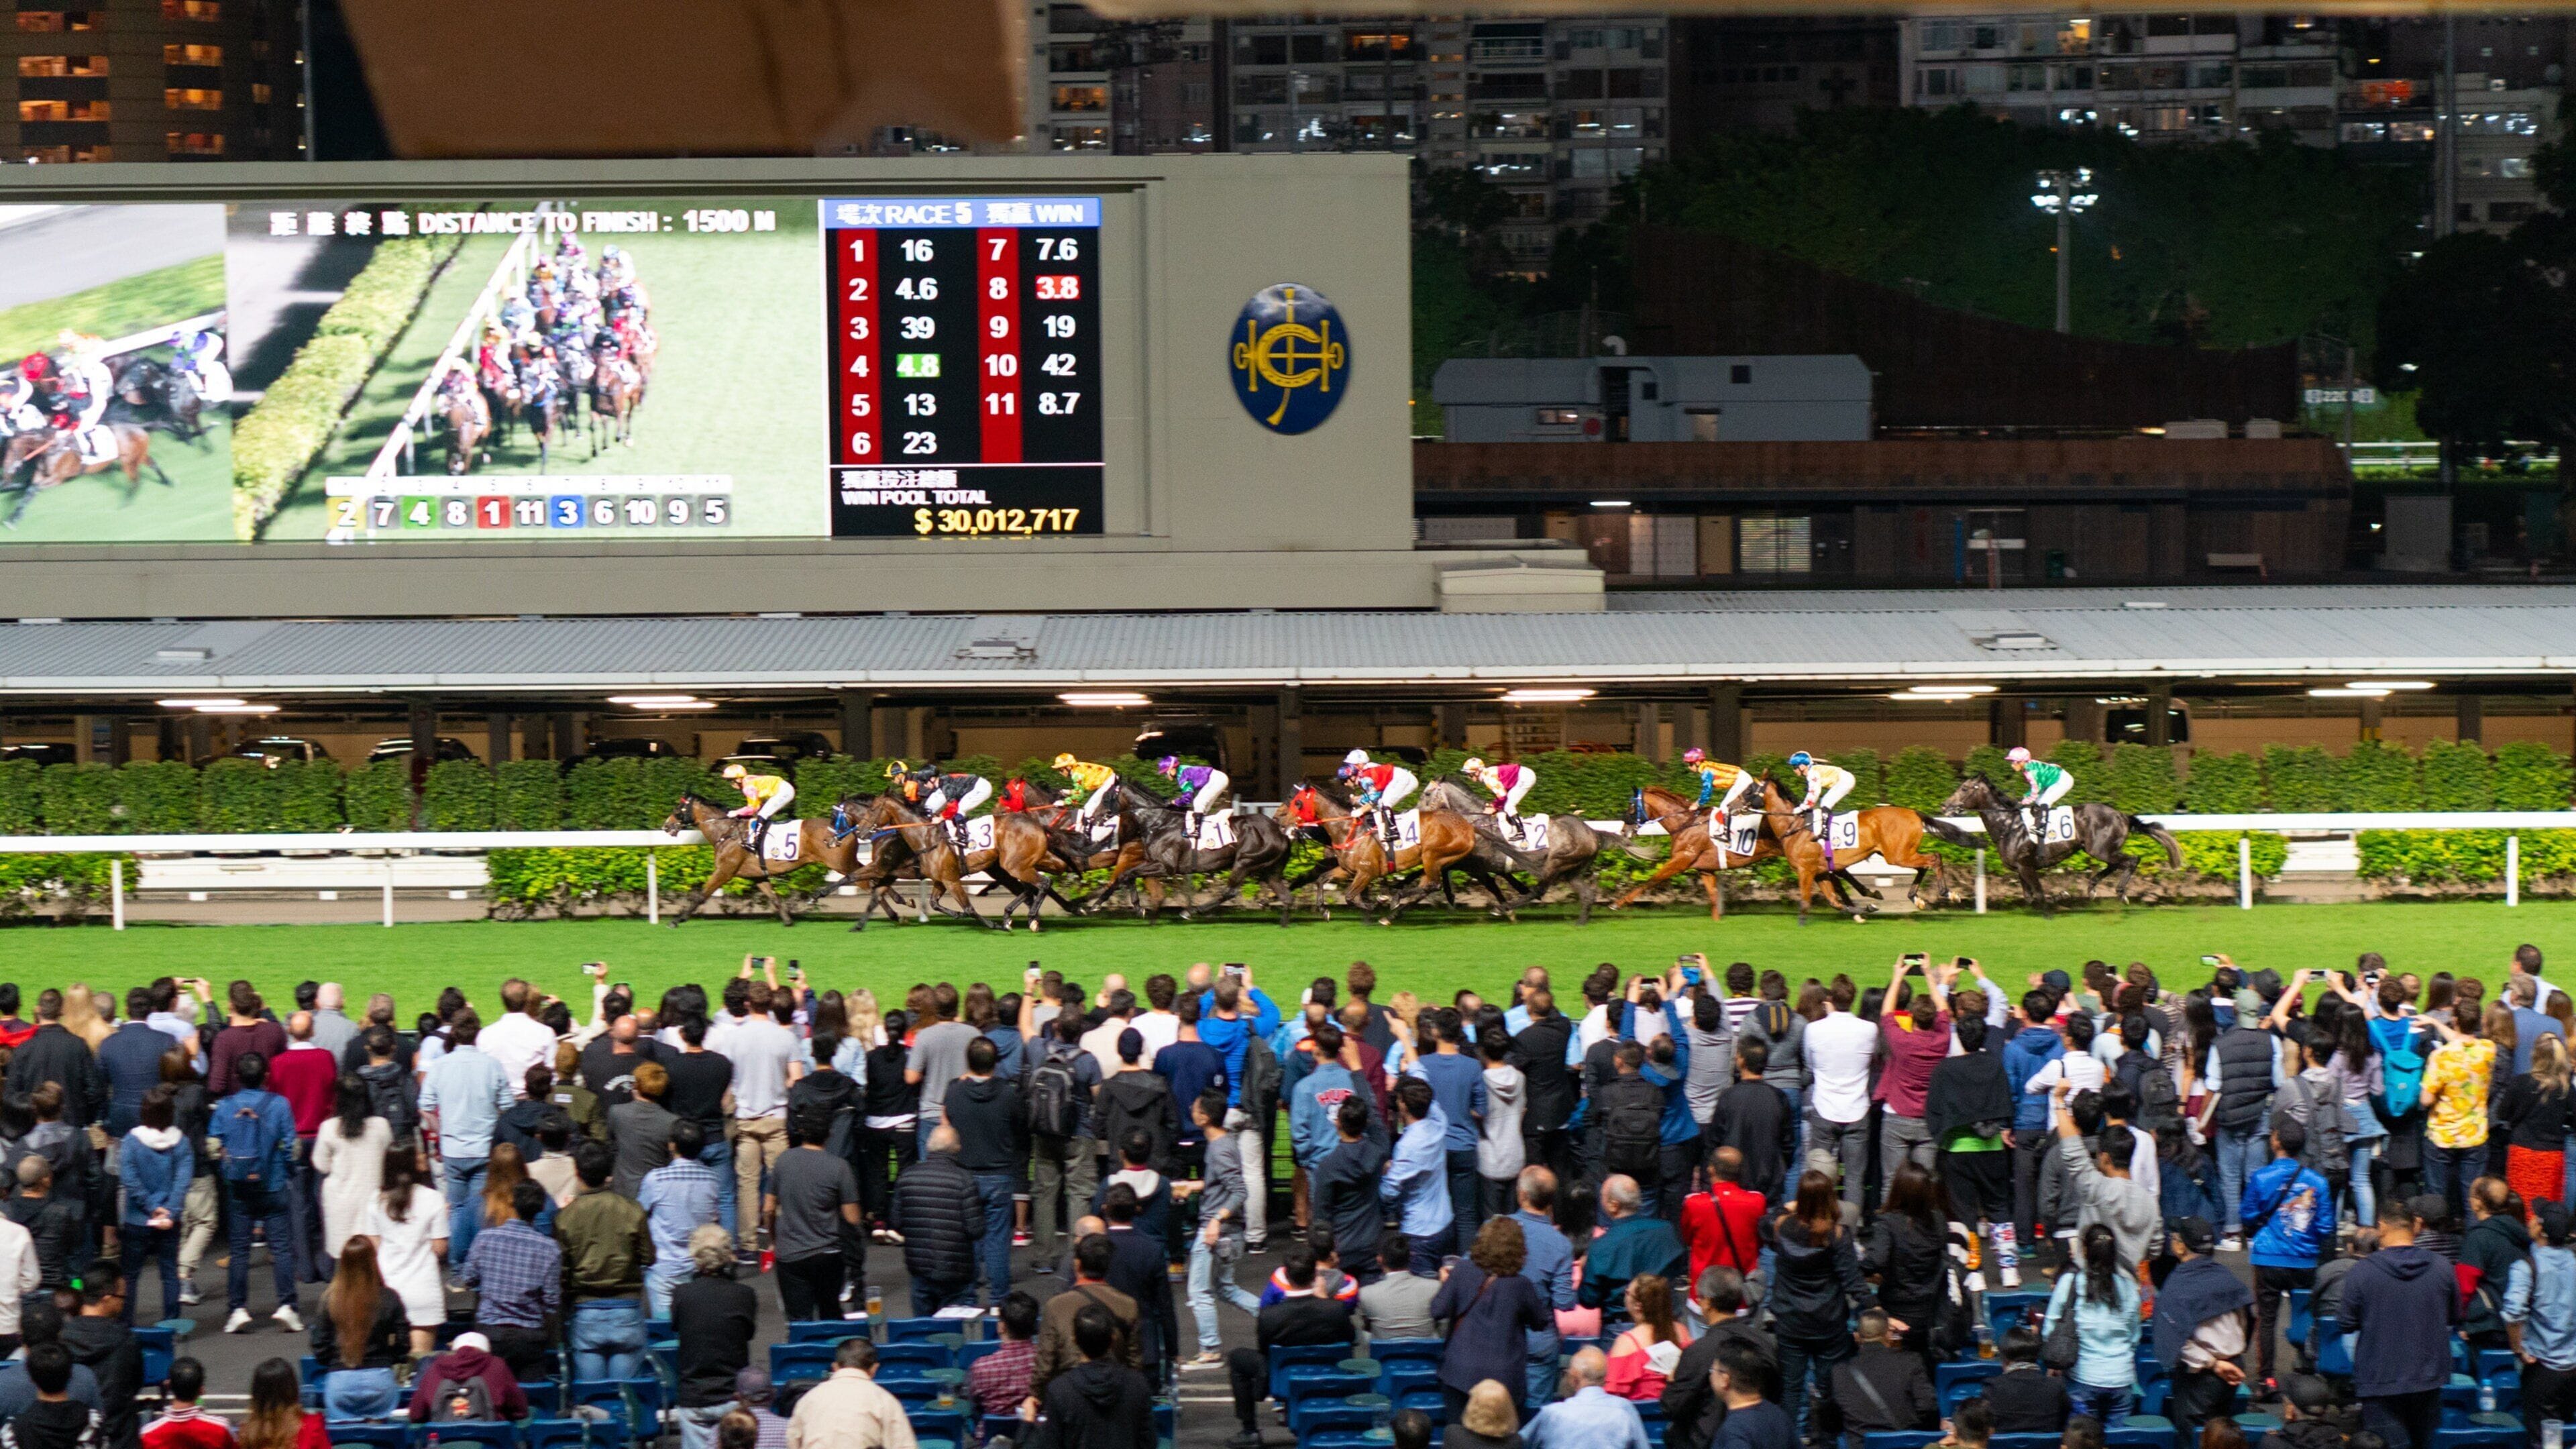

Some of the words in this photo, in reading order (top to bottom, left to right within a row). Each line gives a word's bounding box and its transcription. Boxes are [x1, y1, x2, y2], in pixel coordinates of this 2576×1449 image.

[419, 213, 536, 233] DISTANCE
[541, 212, 577, 233] TO
[583, 212, 657, 231] FINISH
[683, 210, 749, 232] 1500
[885, 206, 951, 223] RACE
[956, 203, 972, 223] 5
[1036, 205, 1083, 222] WIN
[851, 240, 863, 262] 1
[901, 239, 933, 262] 16
[989, 239, 1006, 260] 7
[1036, 238, 1078, 260] 7.6
[849, 278, 867, 301] 2
[896, 278, 938, 300] 4.6
[989, 277, 1008, 299] 8
[1037, 276, 1078, 299] 3.8
[851, 317, 869, 339] 3
[902, 317, 934, 339] 39
[990, 316, 1008, 338] 9
[1043, 315, 1075, 337] 19
[851, 356, 869, 377] 4
[897, 354, 939, 377] 4.8
[985, 354, 1017, 376] 10
[1042, 354, 1076, 376] 42
[852, 394, 870, 416] 5
[904, 394, 936, 415] 13
[985, 393, 1014, 415] 11
[1039, 392, 1080, 415] 8.7
[853, 432, 871, 454] 6
[903, 432, 936, 453] 23
[841, 491, 878, 504] WIN
[880, 490, 932, 504] POOL
[932, 490, 991, 504] TOTAL
[337, 501, 357, 526] 2
[374, 502, 394, 527] 7
[409, 501, 430, 525] 4
[447, 500, 467, 526] 8
[484, 500, 500, 525] 1
[515, 500, 544, 525] 11
[559, 500, 578, 525] 3
[594, 500, 614, 525] 6
[624, 499, 657, 524] 10
[668, 499, 689, 524] 9
[705, 499, 725, 524] 5
[938, 508, 1079, 535] 30,012,717
[979, 824, 991, 847] 3
[1406, 820, 1418, 842] 4
[1534, 824, 1546, 849] 2
[1843, 822, 1856, 847] 9
[2060, 815, 2073, 839] 6
[784, 833, 797, 859] 5
[1736, 828, 1756, 854] 10
